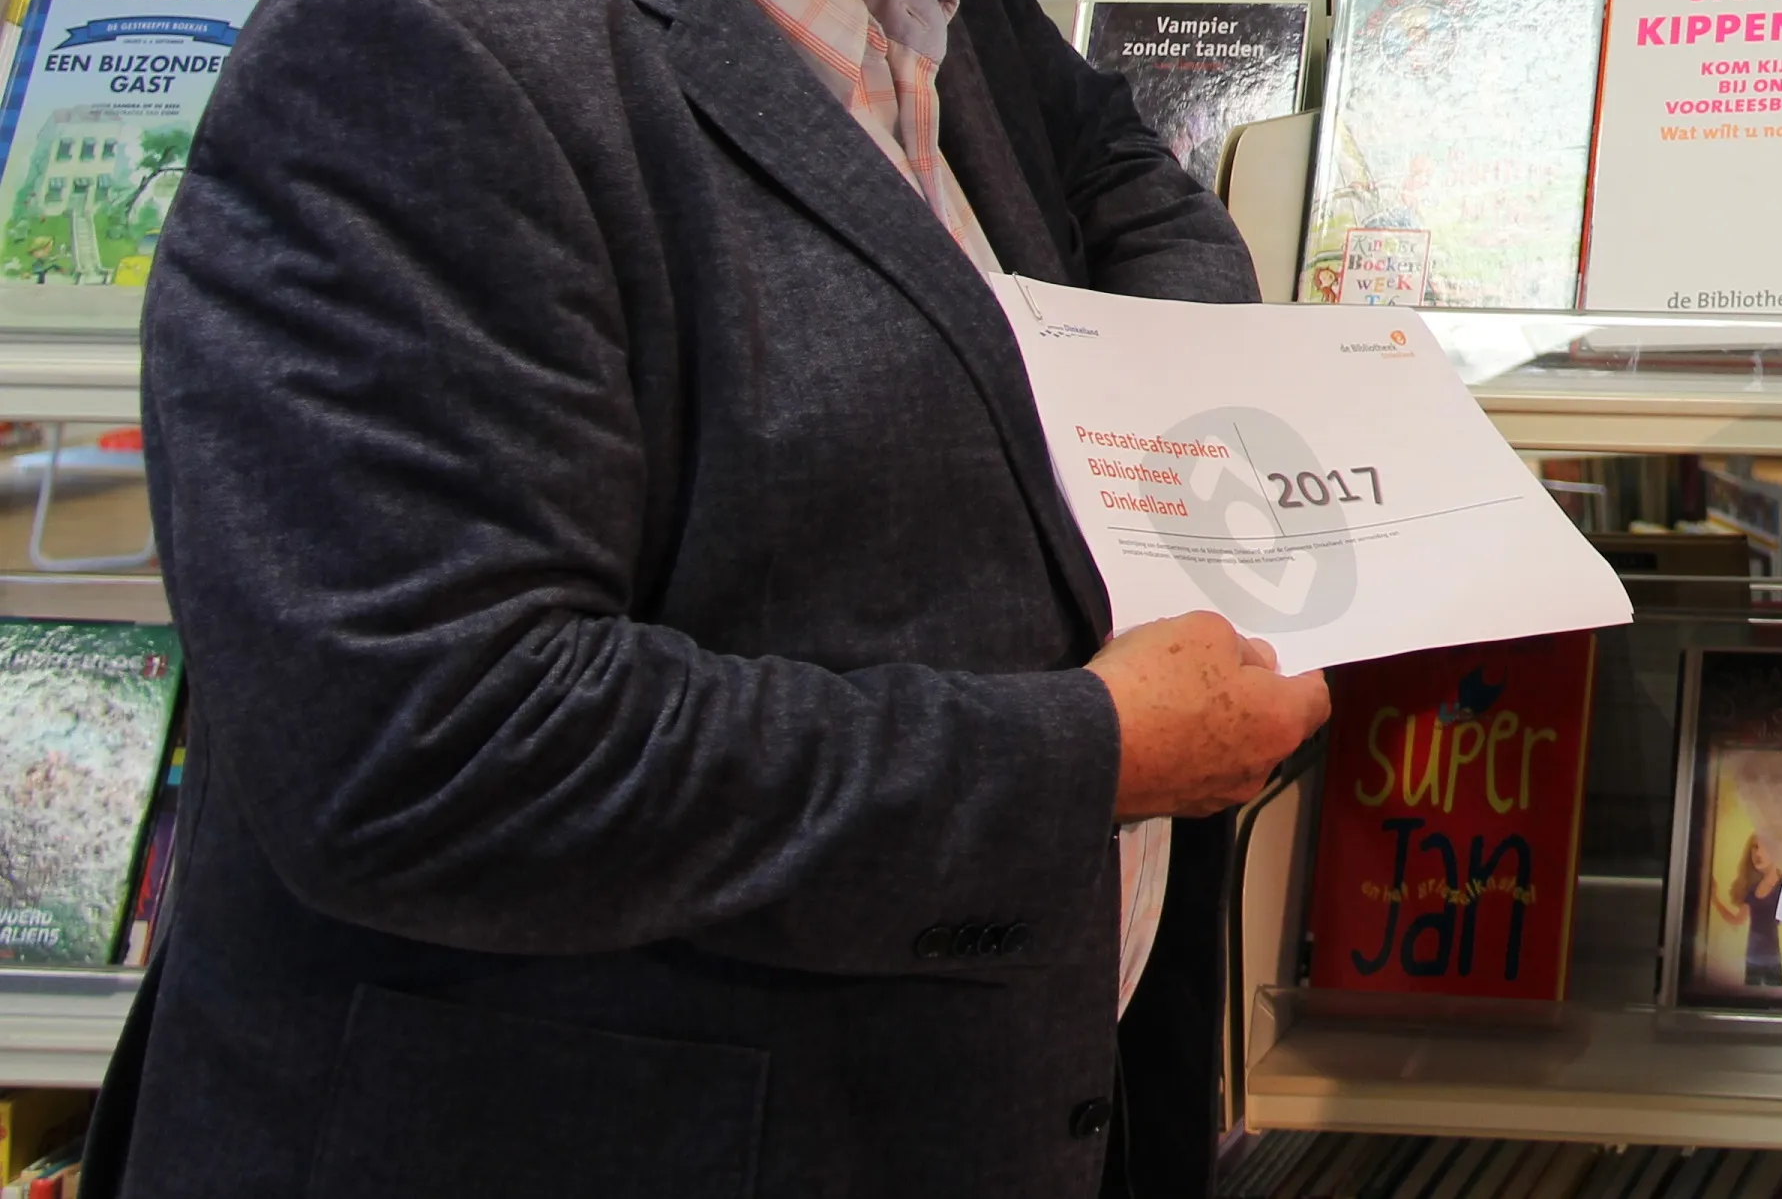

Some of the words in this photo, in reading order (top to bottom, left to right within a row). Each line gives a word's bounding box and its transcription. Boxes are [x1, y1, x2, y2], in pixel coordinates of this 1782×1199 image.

[1157, 16, 1239, 37] Vampier
[1122, 38, 1191, 57] zonder
[1195, 40, 1265, 58] tanden
[44, 54, 92, 72] EEN
[1701, 60, 1751, 76] KOM
[110, 75, 175, 93] GAST
[1718, 80, 1747, 94] BIJ
[1660, 125, 1698, 141] Wat
[1702, 123, 1741, 140] wilt
[1745, 126, 1758, 140] u
[1667, 291, 1691, 310] de
[1075, 425, 1231, 459] Prestatieafspraken
[1087, 457, 1183, 487] Bibliotheek
[1267, 466, 1384, 509] 2017
[1099, 489, 1189, 518] Dinkelland
[1351, 817, 1532, 981] Jan
